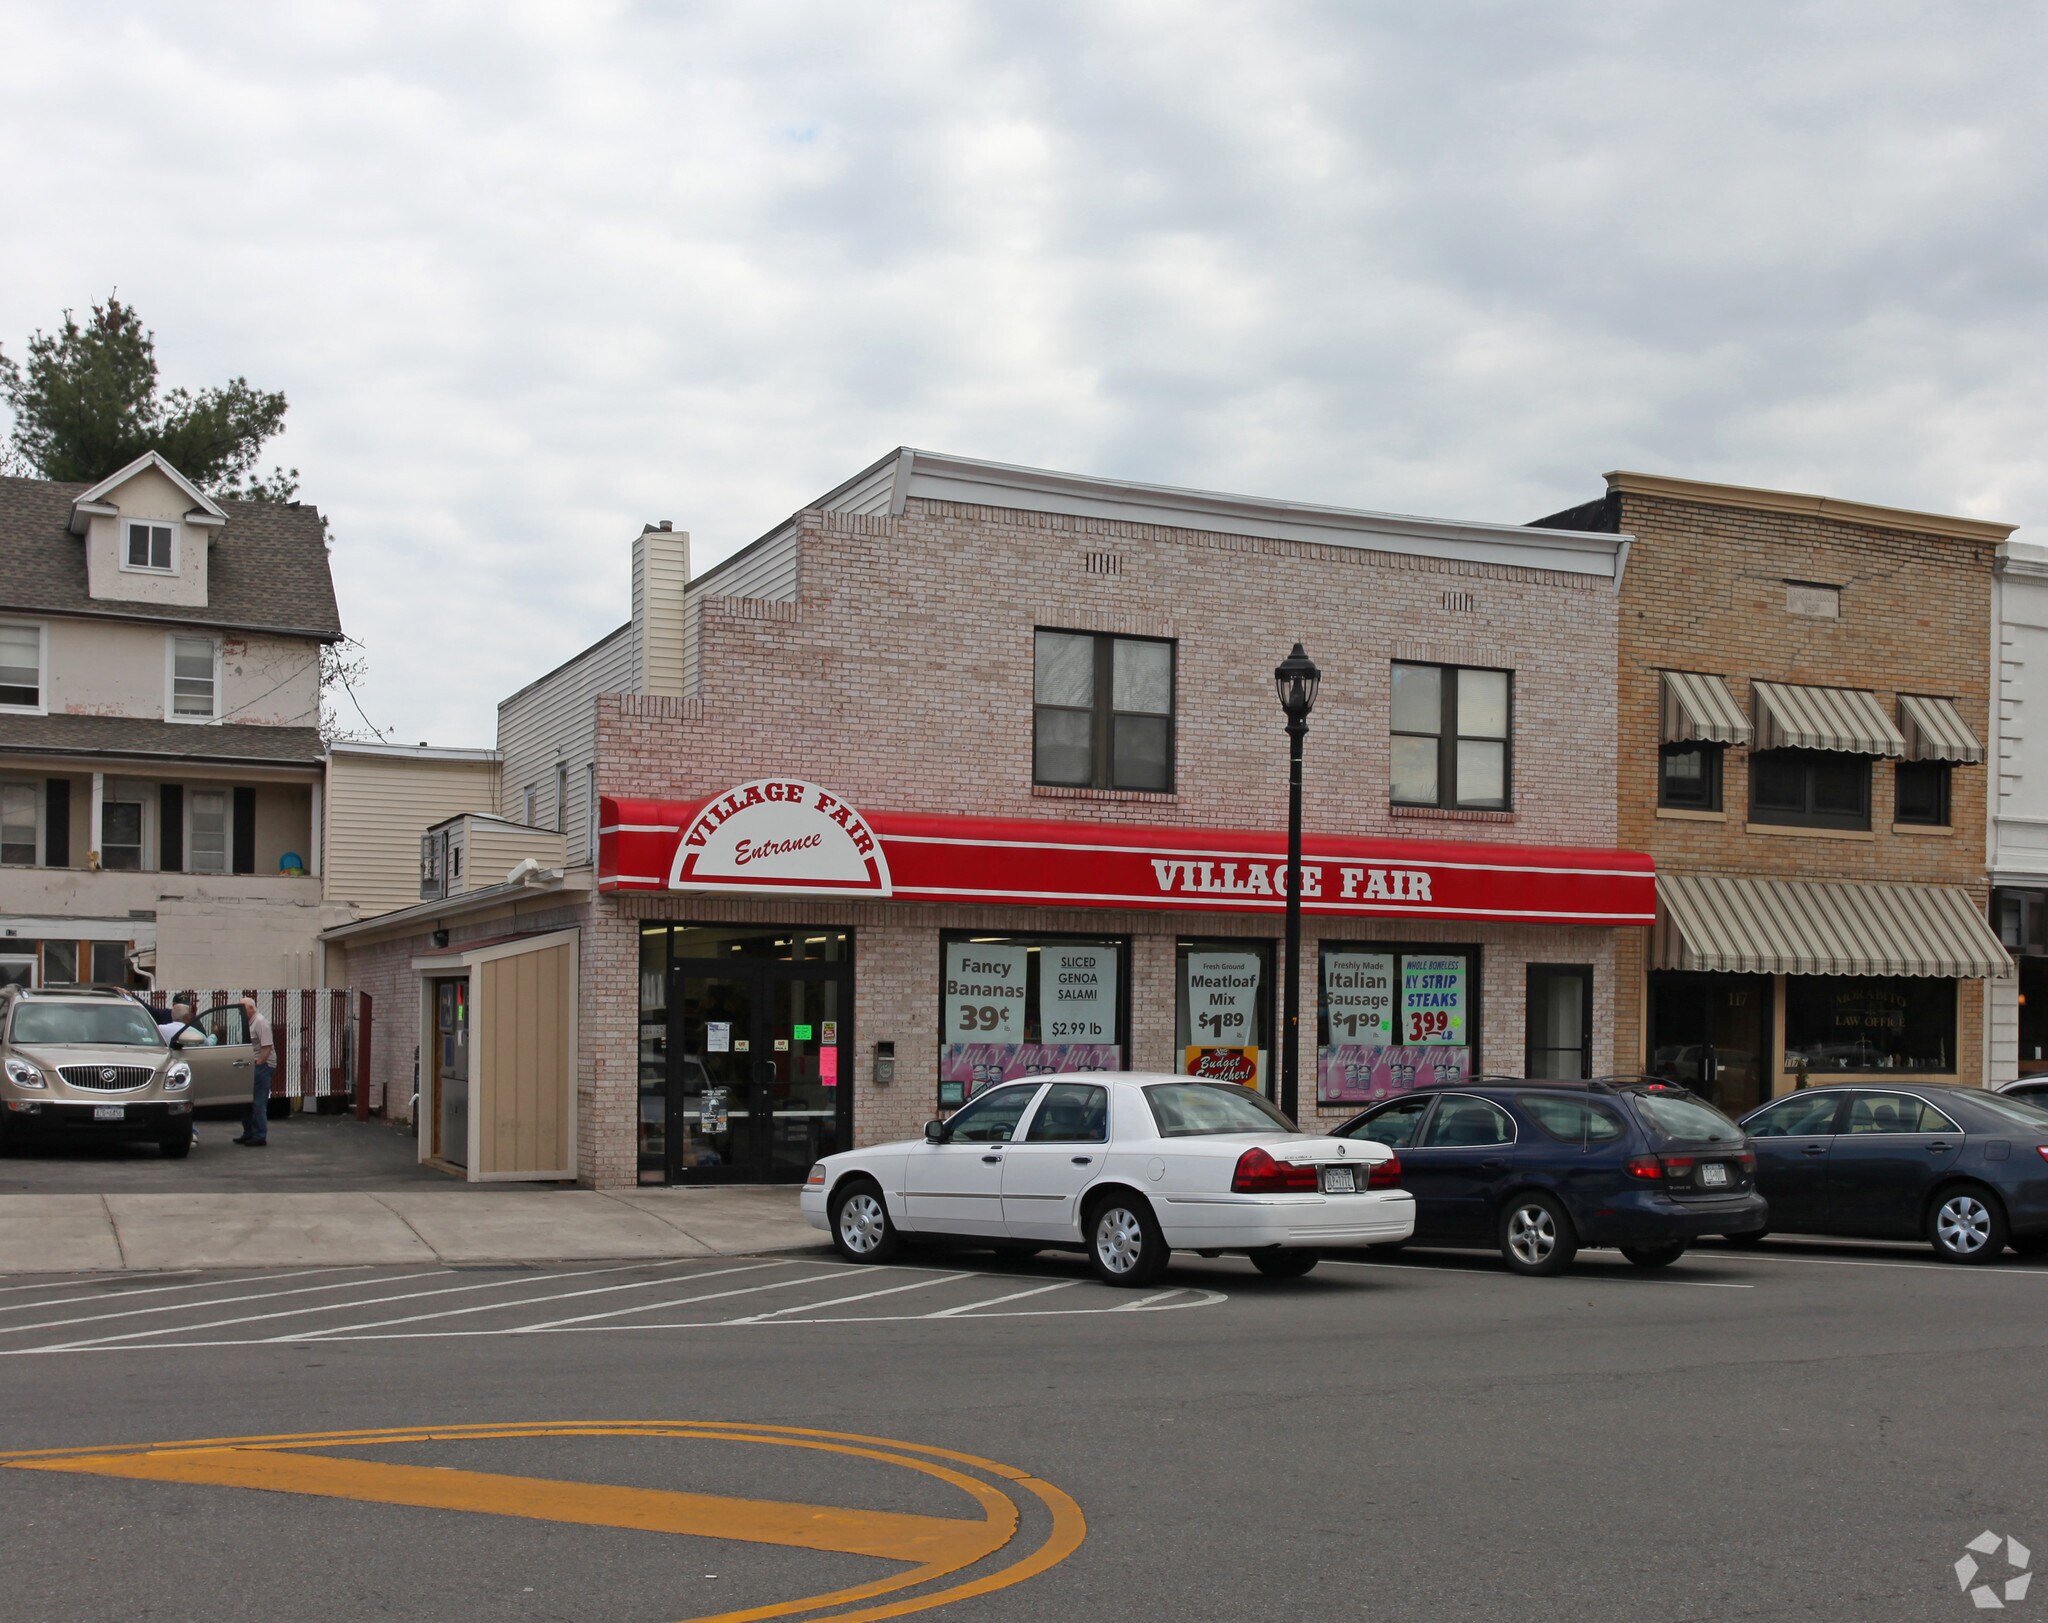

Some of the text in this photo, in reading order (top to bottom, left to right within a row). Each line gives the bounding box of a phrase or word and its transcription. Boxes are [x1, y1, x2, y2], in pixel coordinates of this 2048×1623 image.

[685, 782, 874, 856] VILLAGE FAIR
[735, 833, 822, 865] Entrance
[1151, 859, 1432, 901] VILLAGE FAIR
[962, 958, 1012, 978] Fancy
[1061, 957, 1096, 967] SLICED
[1333, 961, 1384, 971] Freshly Made
[1407, 961, 1459, 970] WHOLE BONELESS
[1058, 973, 1098, 983] GENOA
[1191, 975, 1256, 988] Meatloaf
[1329, 972, 1387, 989] Italian
[1422, 975, 1457, 988] STRIP
[947, 980, 1024, 998] Bananas
[1058, 989, 1097, 999] SALAMI
[1209, 993, 1235, 1005] Mix
[1327, 992, 1389, 1009] Sausage
[1408, 993, 1457, 1007] STEAKS
[1729, 993, 1748, 1006] 117
[1292, 1016, 1297, 1025] 7
[1835, 1015, 1905, 1027] LAW OFFICE
[1052, 1022, 1102, 1037] $2.99 lb
[1200, 1056, 1241, 1069] Budget
